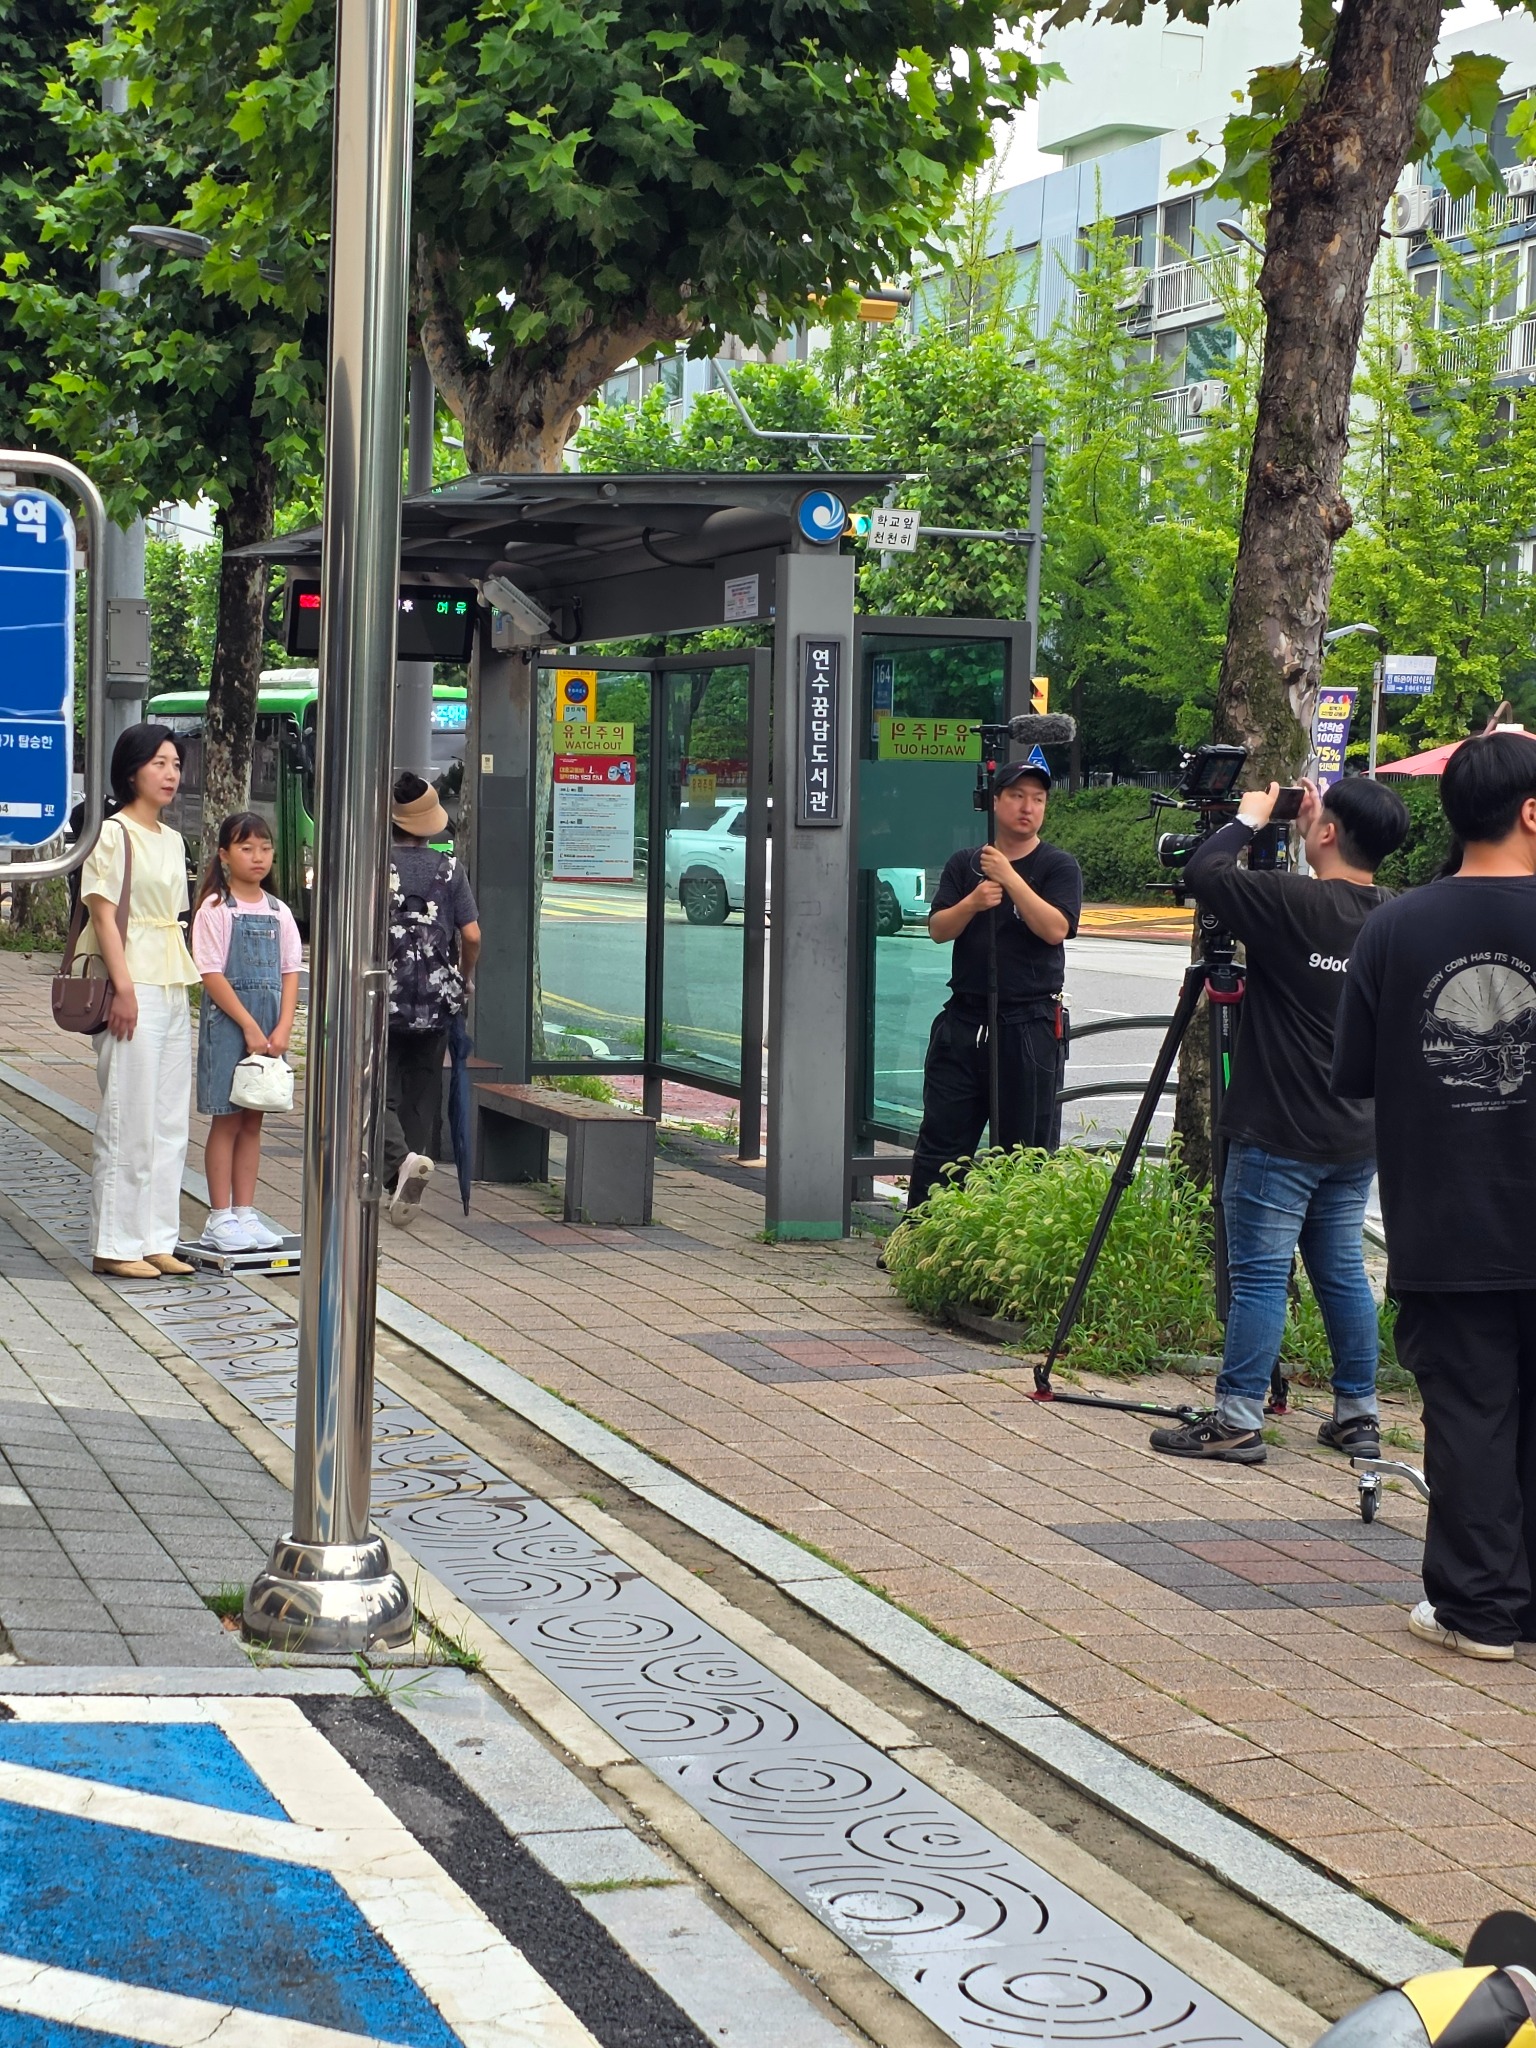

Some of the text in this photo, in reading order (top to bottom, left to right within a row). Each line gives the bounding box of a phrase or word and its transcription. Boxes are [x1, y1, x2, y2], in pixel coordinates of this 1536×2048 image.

[0, 499, 46, 543] 역
[877, 514, 914, 529] 학교앞
[873, 531, 911, 545] 천천히
[810, 649, 830, 812] 연수꿈담도서관
[1317, 721, 1345, 733] 선착순
[0, 734, 53, 749] 가 탑승한
[565, 741, 622, 750] WATCH OUT
[1422, 951, 1531, 999] EVERY COIN HAS ITS TWO
